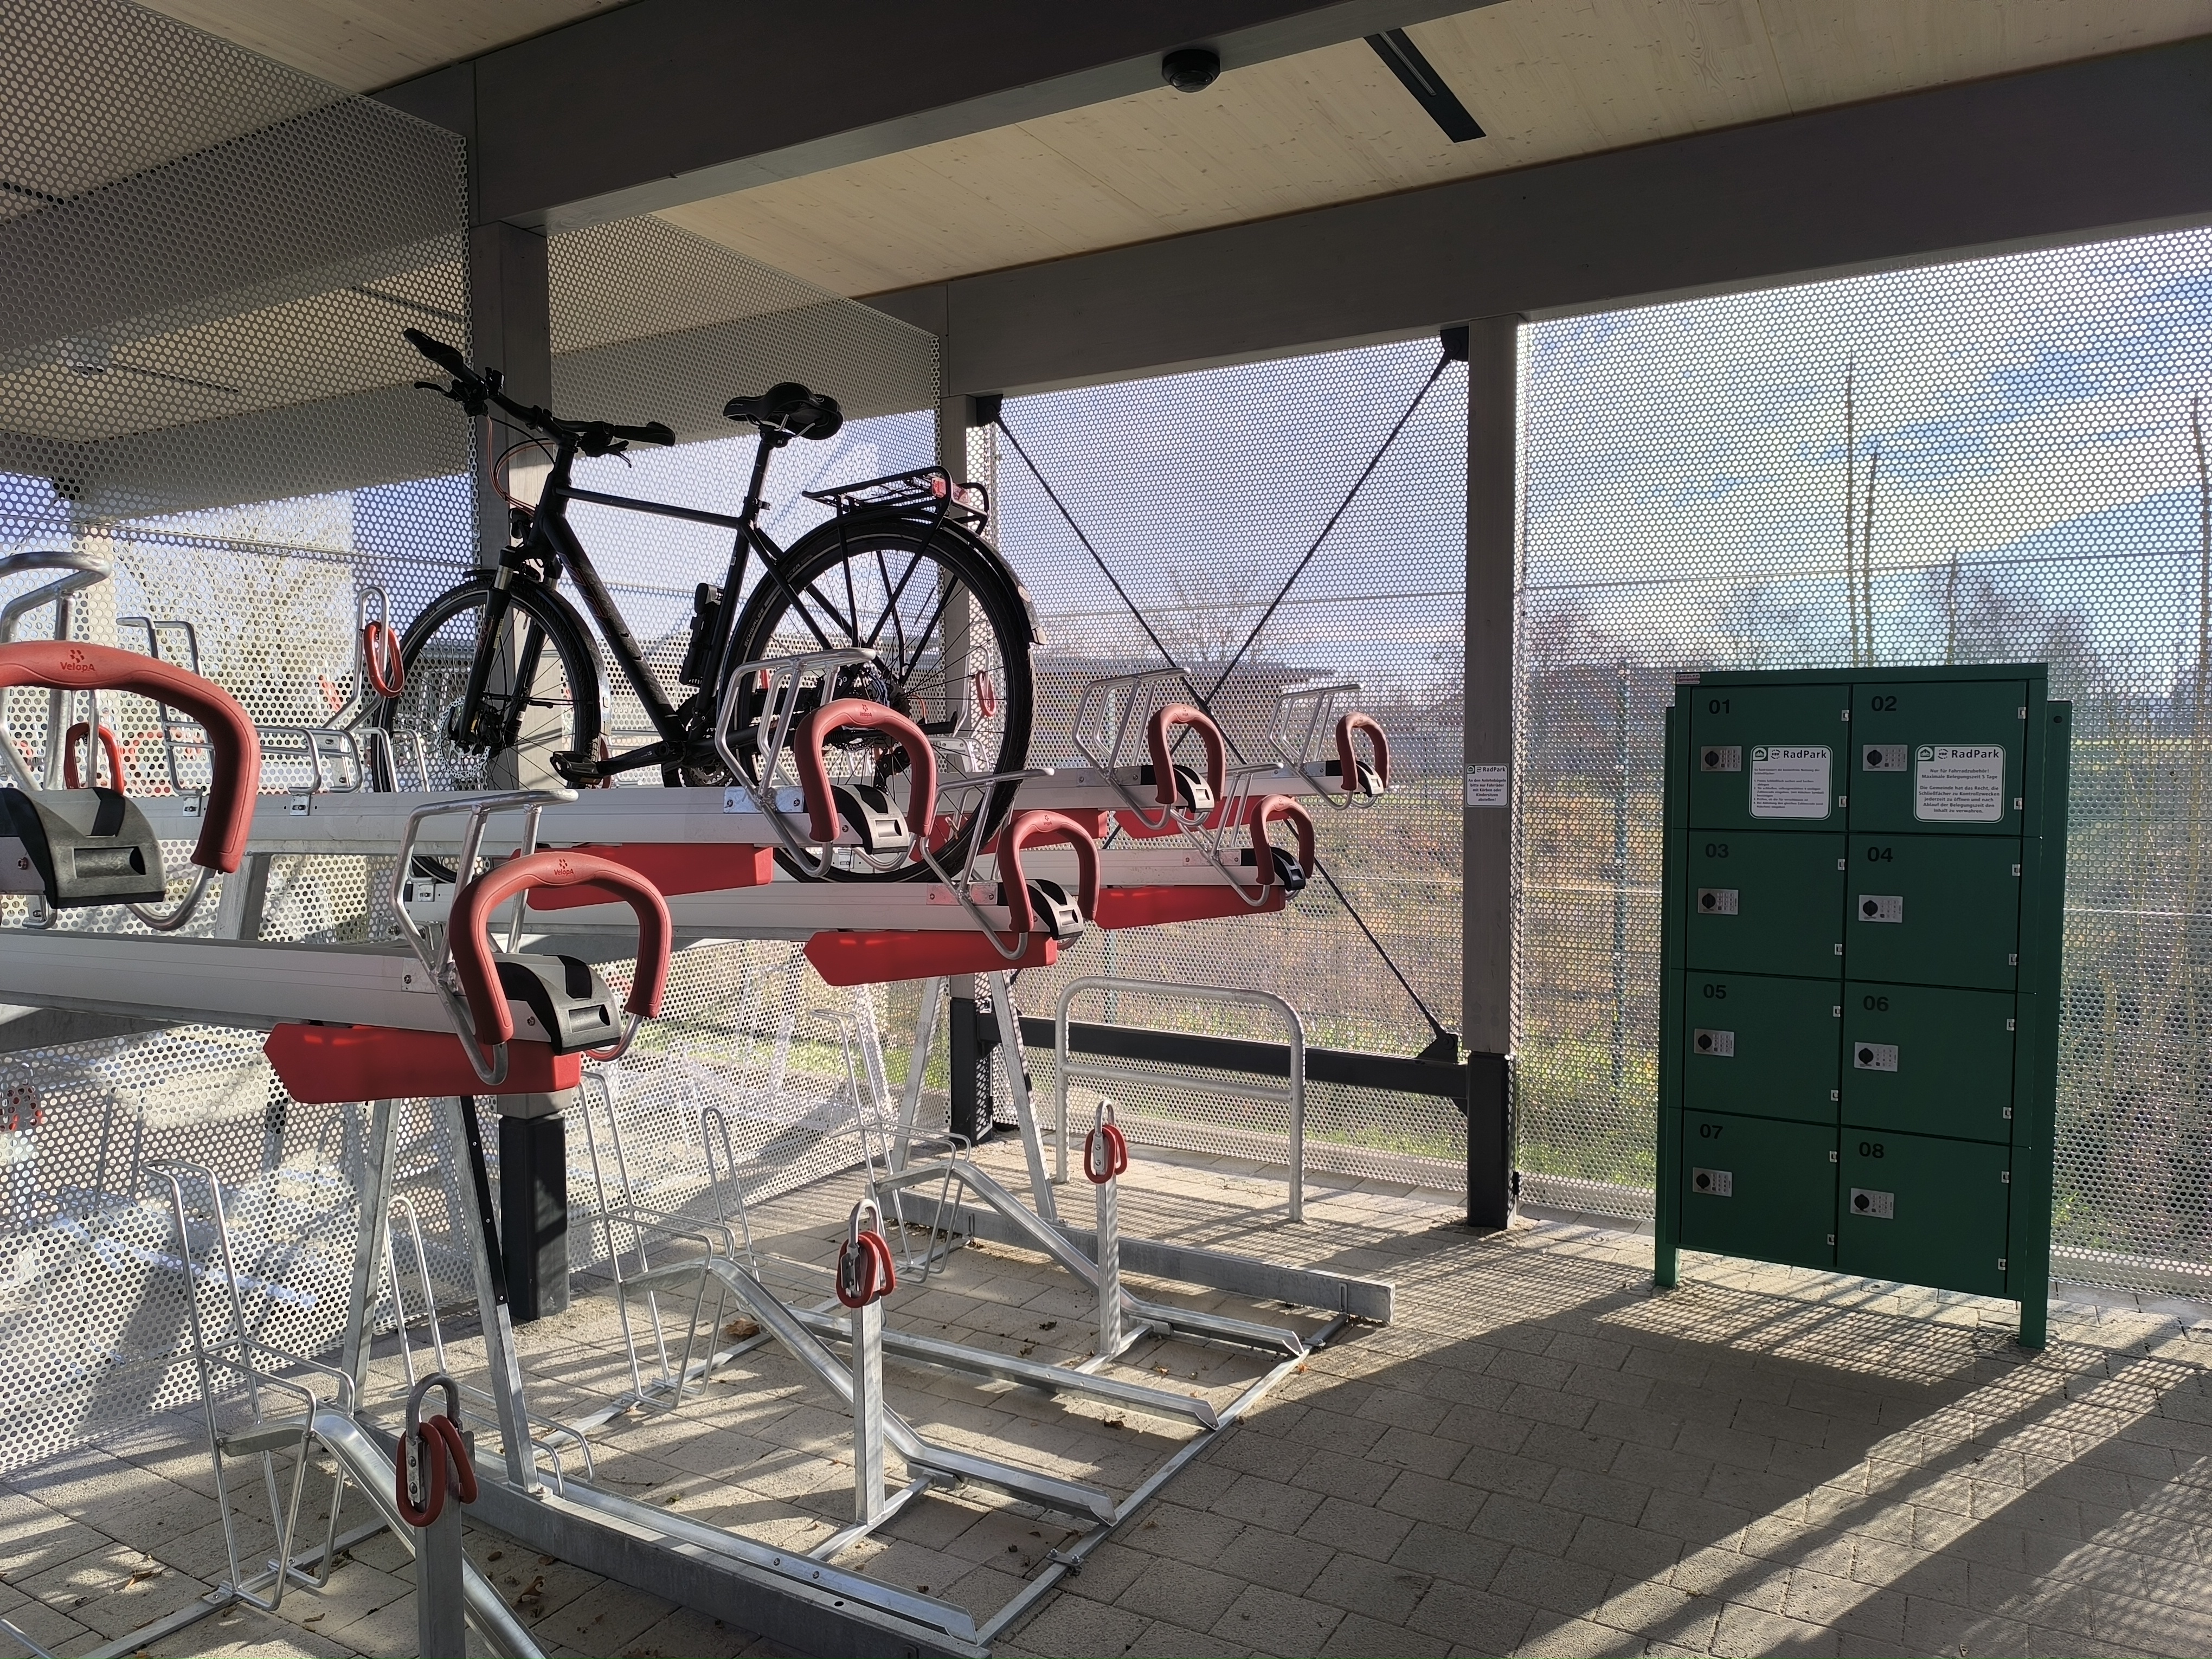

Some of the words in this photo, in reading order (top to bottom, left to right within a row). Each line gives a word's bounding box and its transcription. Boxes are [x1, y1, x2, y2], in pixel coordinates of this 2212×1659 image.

[744, 607, 764, 647] SCHWALBE
[60, 661, 96, 672] VelopA
[1709, 699, 1730, 714] 01
[1872, 696, 1897, 711] 02
[1783, 749, 1827, 758] RadPark
[1952, 749, 1999, 758] RadPark
[1706, 843, 1729, 858] 03
[1867, 846, 1894, 863] 04
[554, 868, 574, 876] VelopA
[1703, 983, 1727, 999] 05
[1863, 995, 1889, 1012] 06
[1700, 1123, 1724, 1140] 07
[1859, 1142, 1885, 1159] 08
